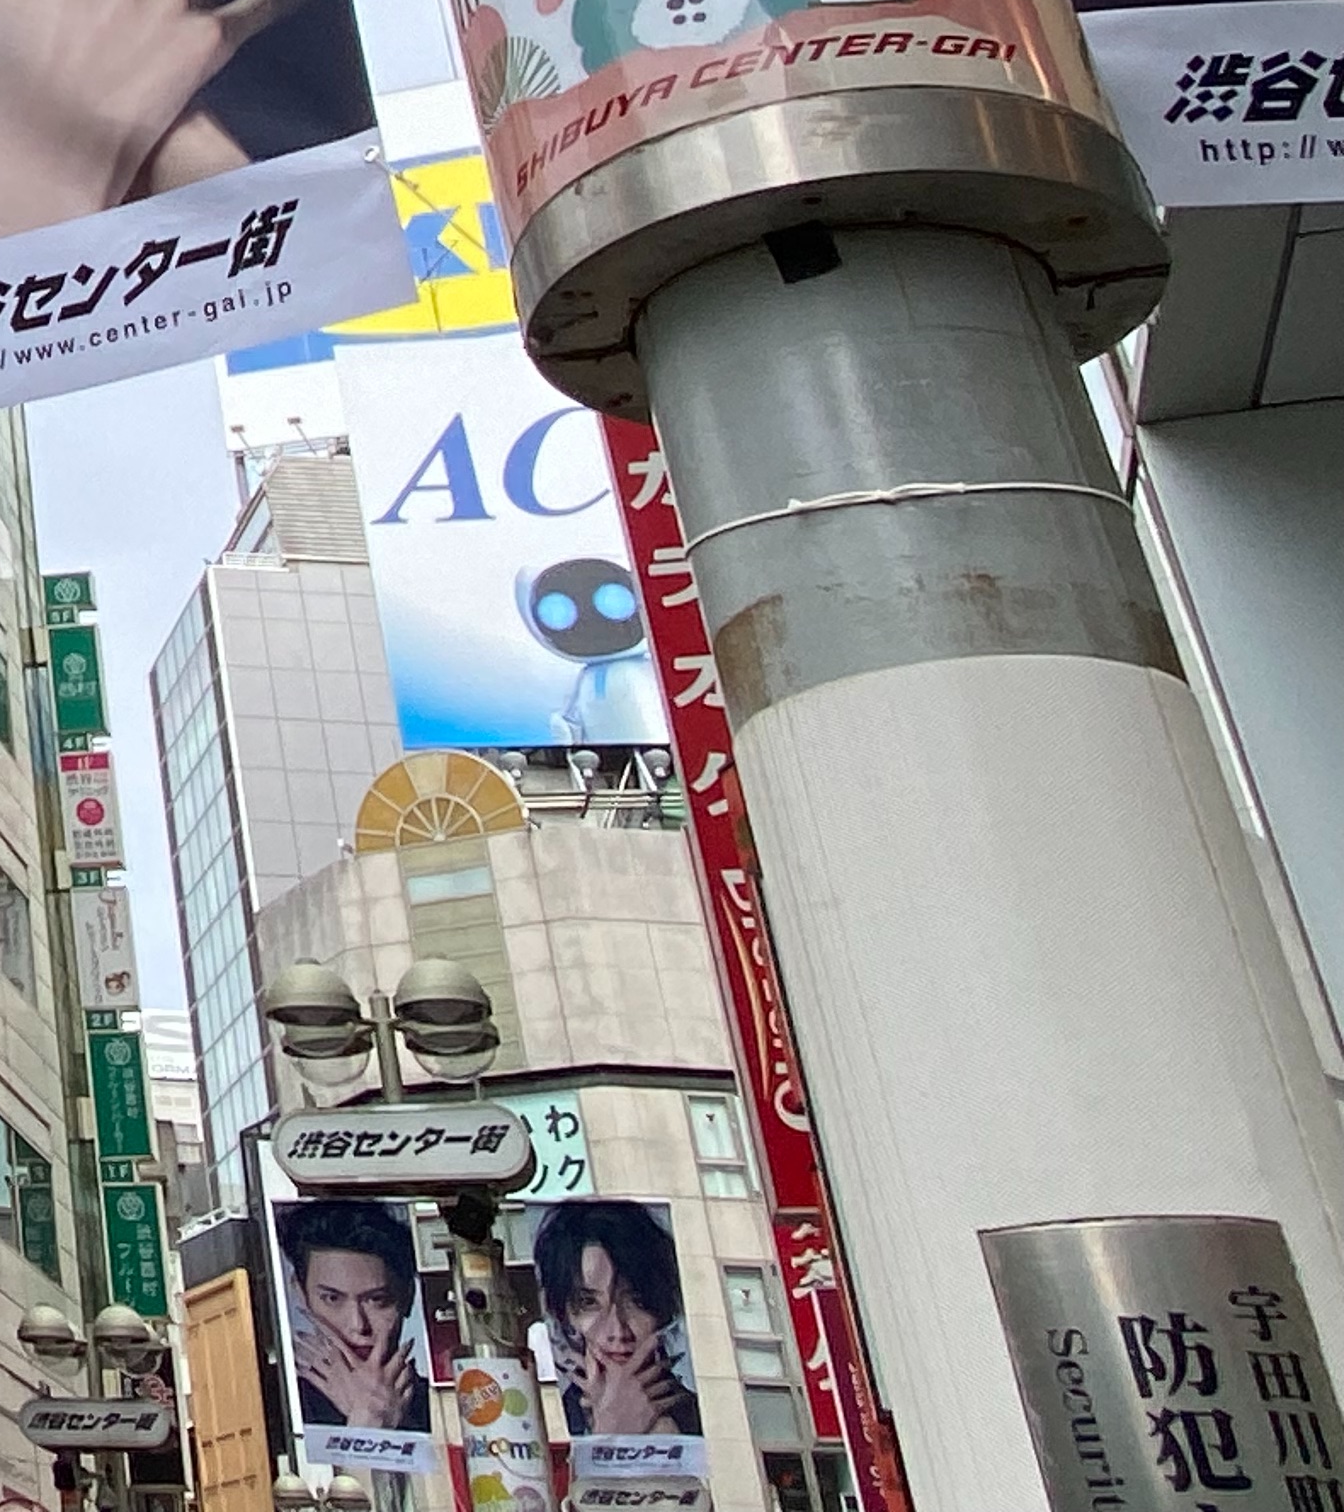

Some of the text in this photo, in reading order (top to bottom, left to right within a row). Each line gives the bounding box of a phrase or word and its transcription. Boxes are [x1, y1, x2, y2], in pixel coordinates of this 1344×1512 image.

[517, 31, 1018, 198] SHIBUYA CENTER-GAI
[287, 1124, 510, 1160] 渋谷センター街
[1118, 1311, 1253, 1512] 防犯
